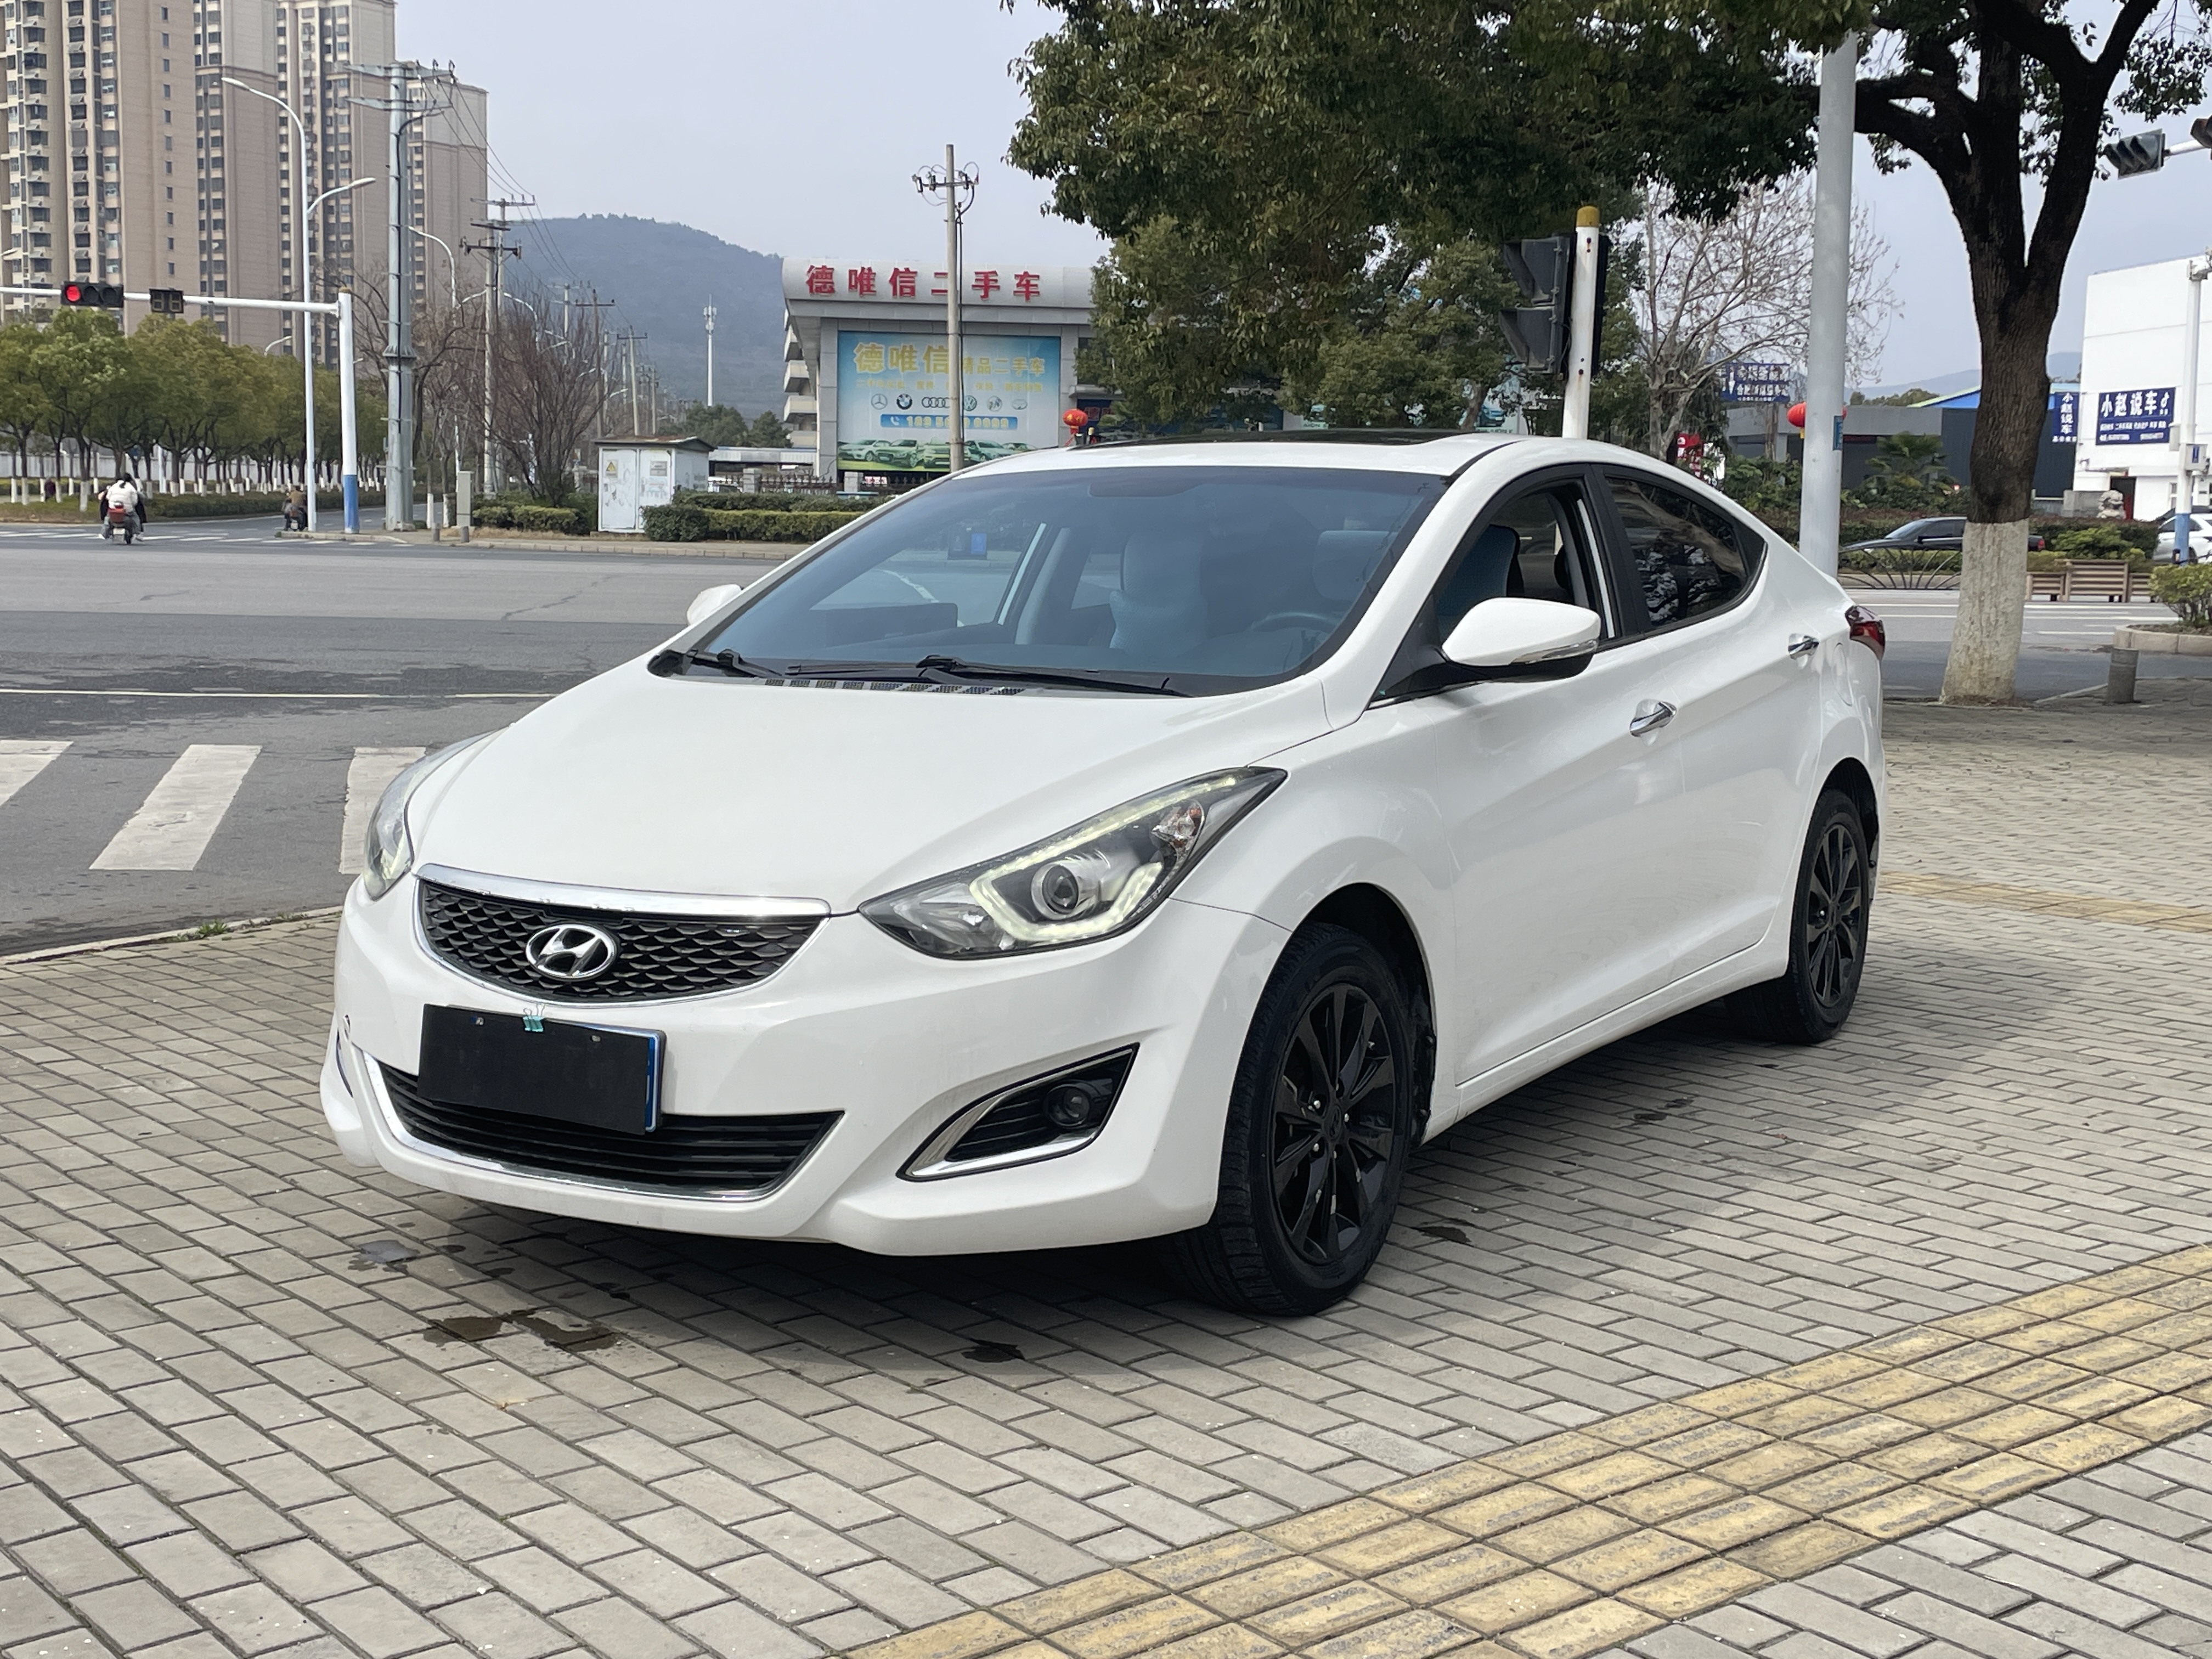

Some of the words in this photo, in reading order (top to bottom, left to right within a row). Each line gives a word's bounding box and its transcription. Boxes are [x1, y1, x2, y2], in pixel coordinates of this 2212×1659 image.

[805, 265, 1040, 301] 德唯信二手车
